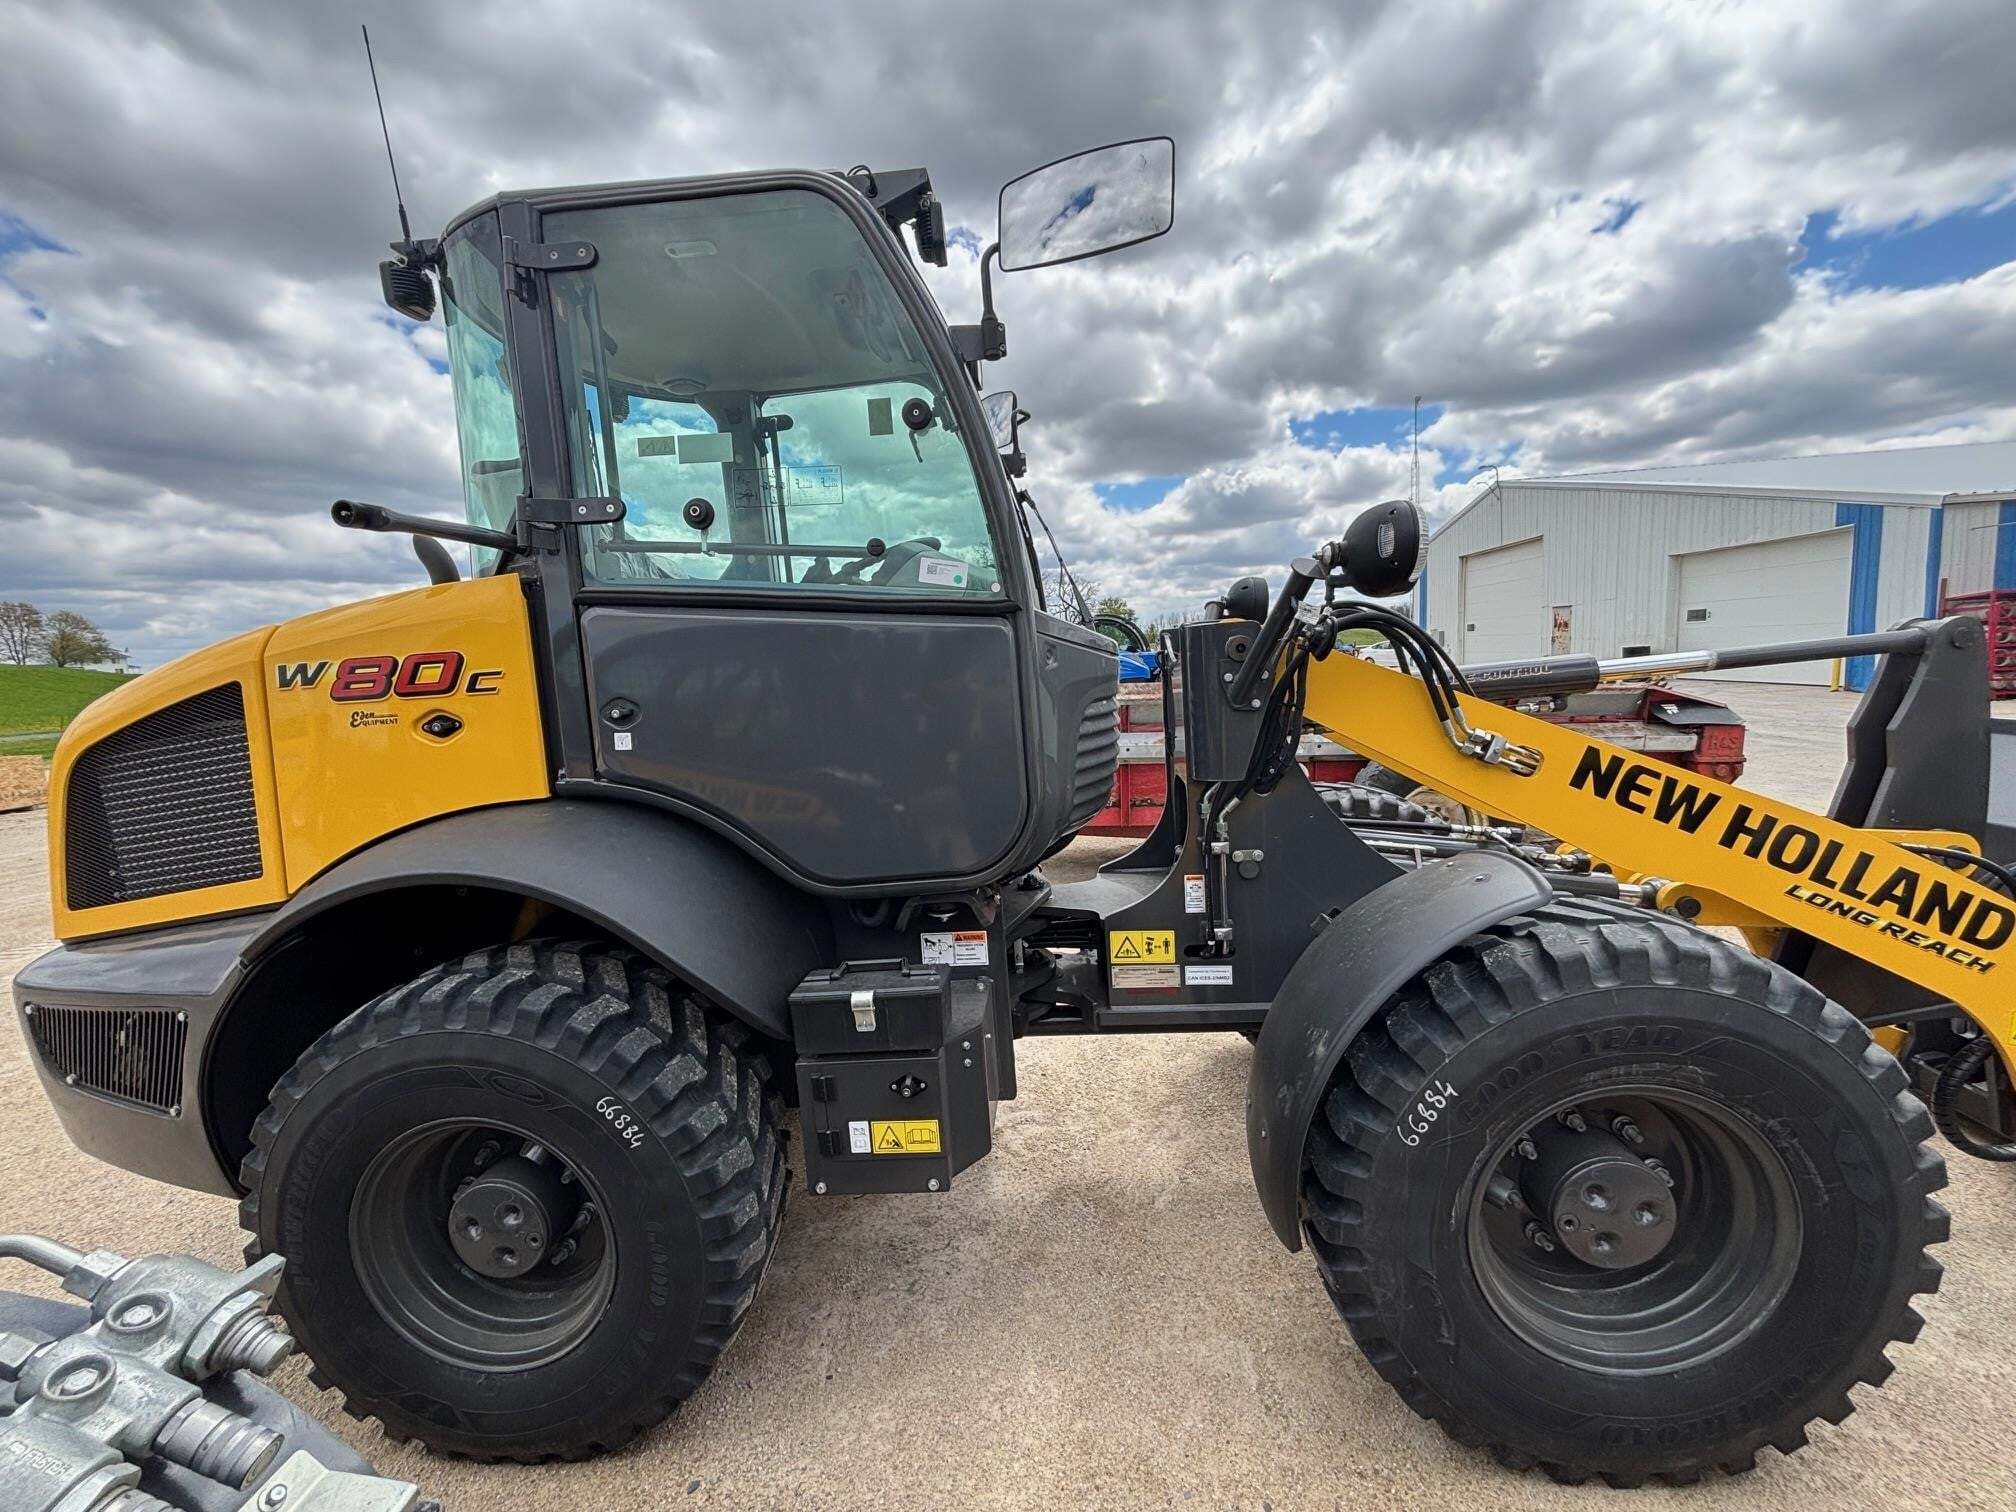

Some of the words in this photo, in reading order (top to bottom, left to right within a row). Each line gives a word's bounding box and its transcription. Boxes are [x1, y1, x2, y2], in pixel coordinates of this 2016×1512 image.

[1480, 664, 1553, 682] CONTROL
[1569, 745, 1722, 834] NEW
[1718, 804, 2016, 951] HOLLAND
[1784, 884, 1881, 928] LONG
[1878, 921, 1996, 974] REACH
[596, 1096, 645, 1149] 66884
[1396, 1080, 1460, 1146] 66884
